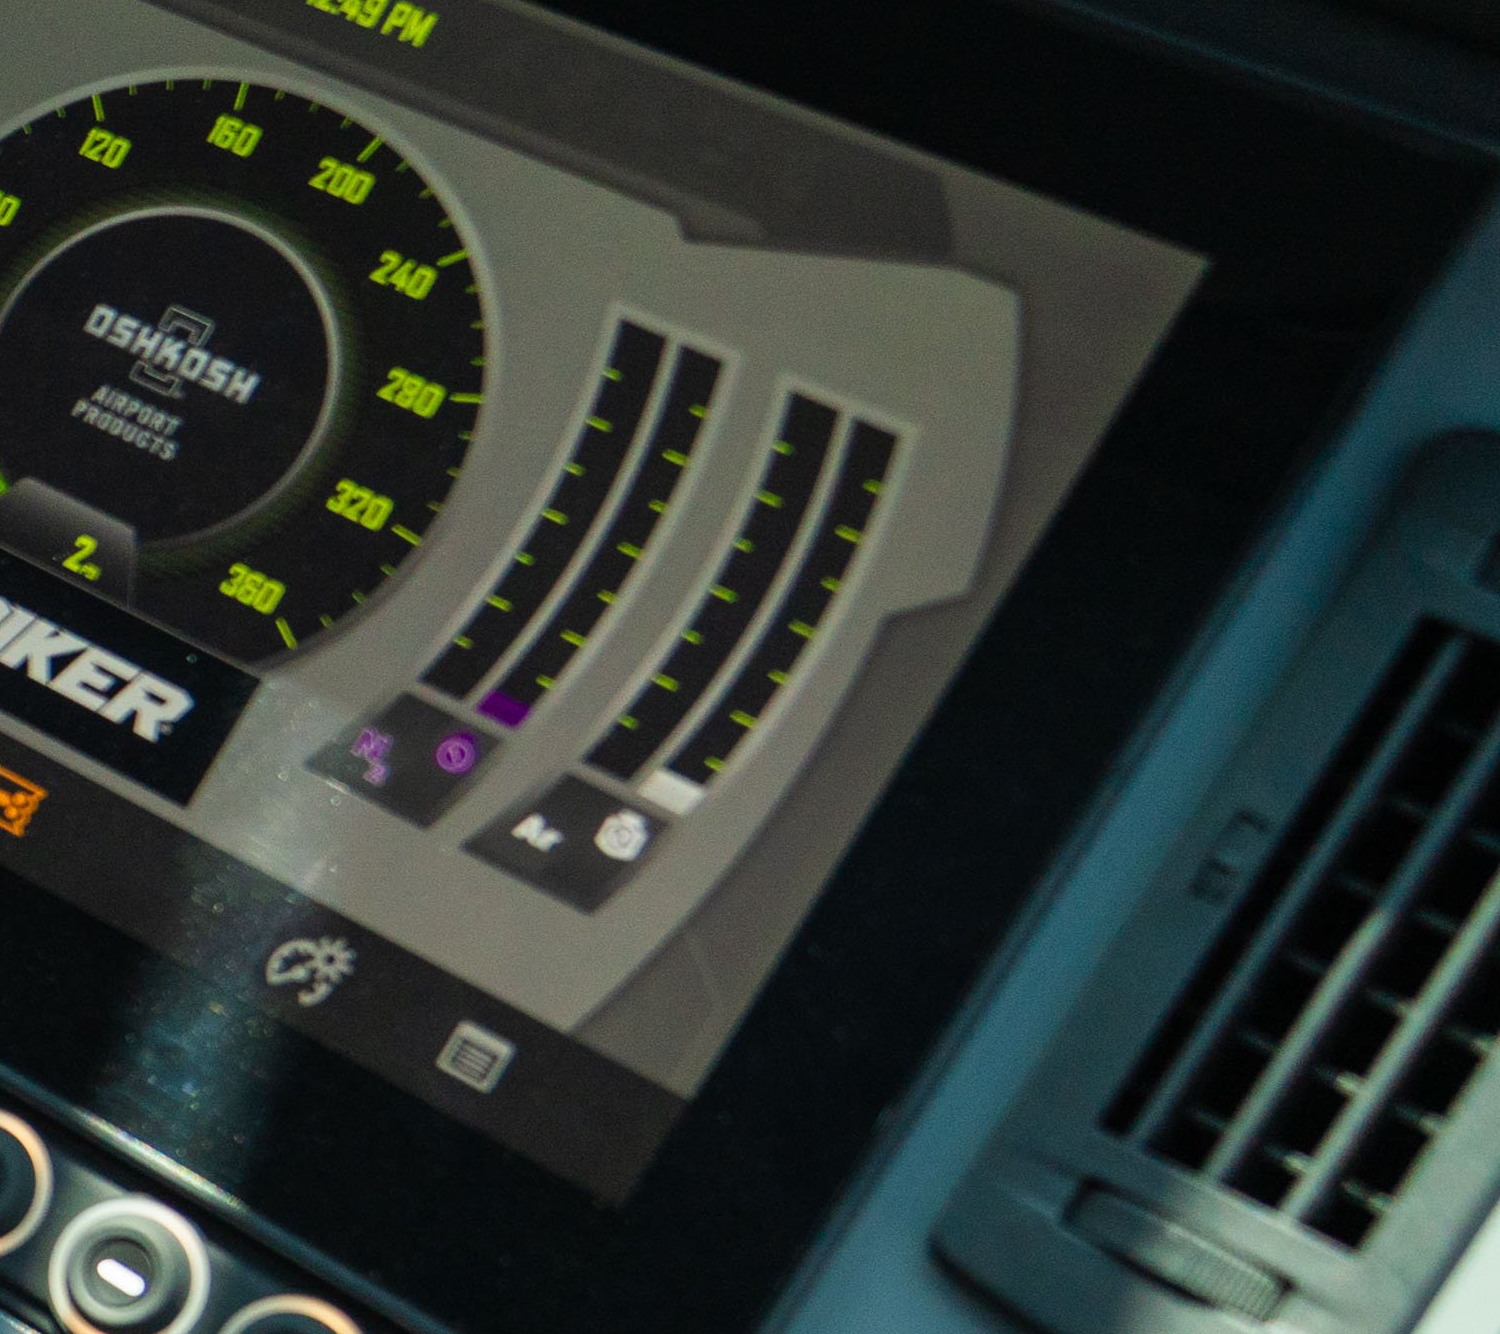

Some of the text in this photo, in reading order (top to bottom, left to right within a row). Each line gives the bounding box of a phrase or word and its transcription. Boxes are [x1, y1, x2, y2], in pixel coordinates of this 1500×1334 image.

[380, 0, 439, 49] PM
[78, 127, 132, 170] 120
[206, 113, 264, 158] 160
[308, 156, 377, 206] 200
[370, 250, 439, 301] 240
[82, 303, 264, 406] OSHKOSH
[91, 384, 185, 437] AIRPORT
[376, 367, 447, 419] 280
[71, 399, 181, 462] PRODUCTS
[326, 477, 395, 533] 320
[219, 562, 288, 616] 360
